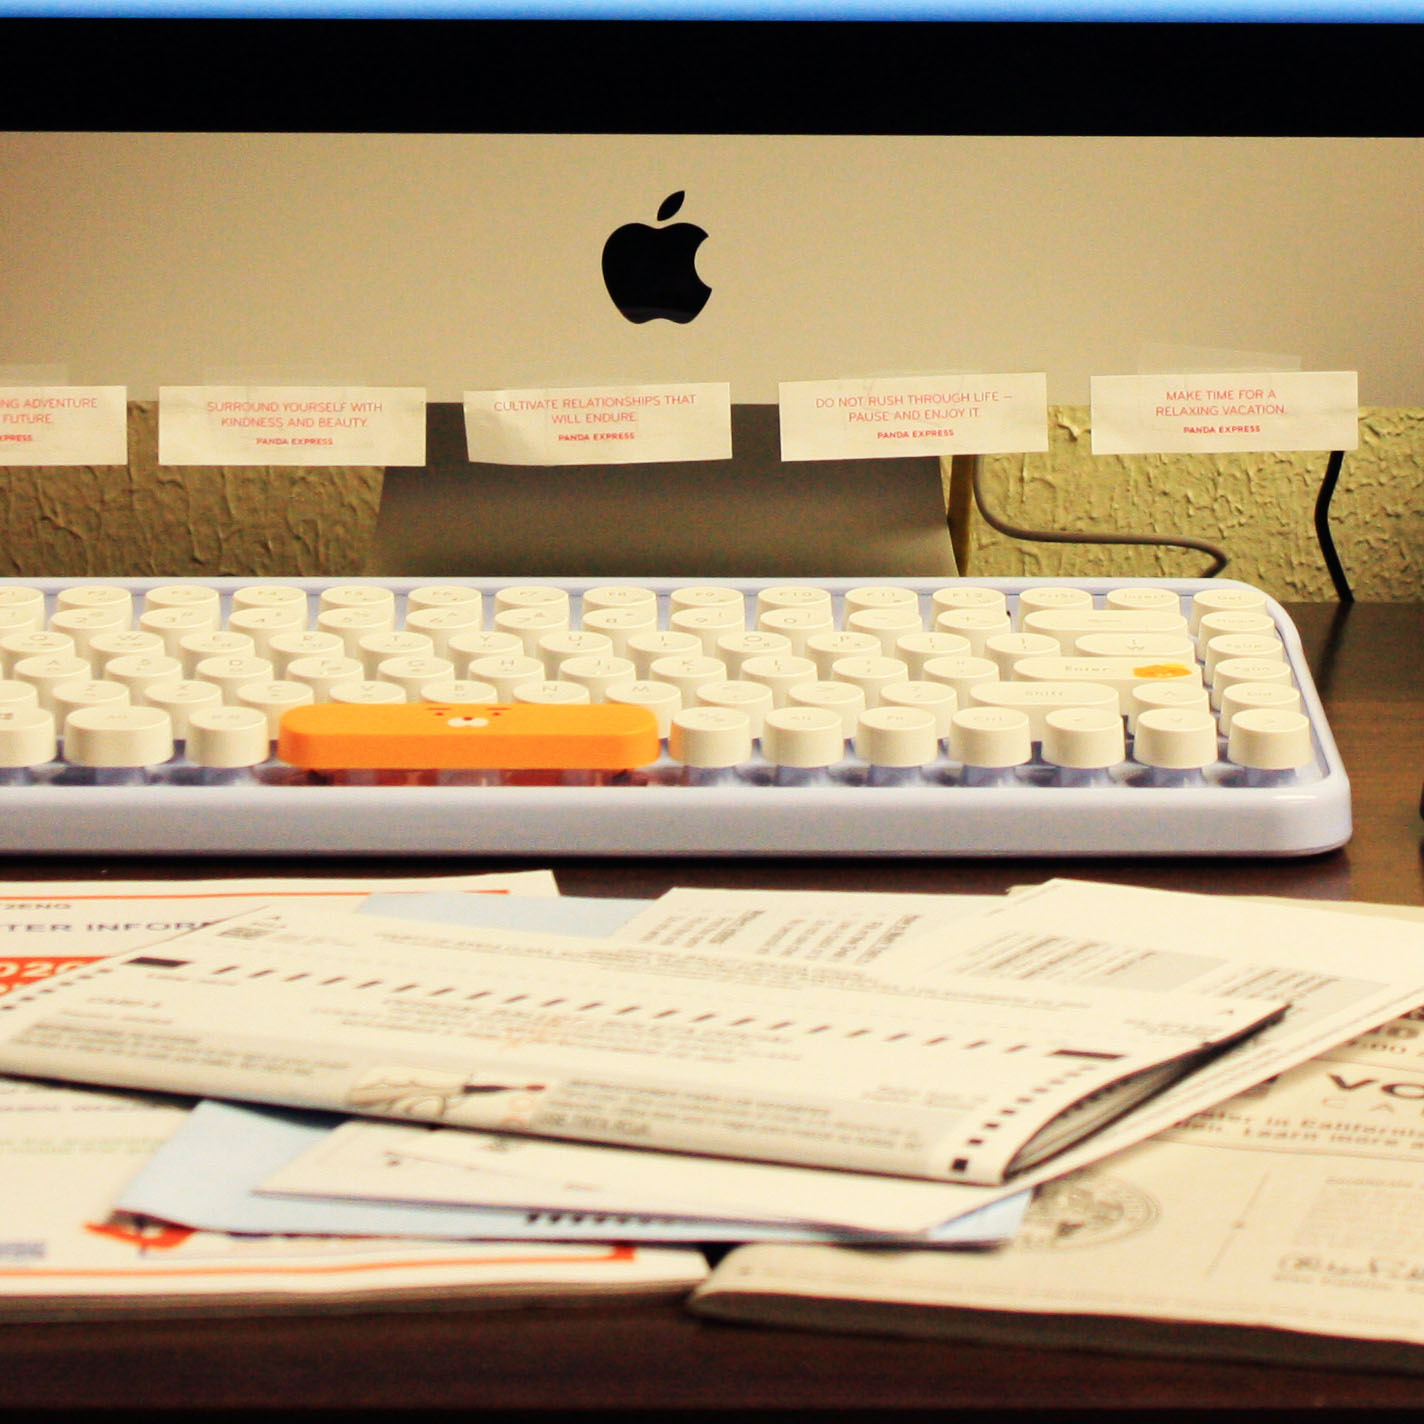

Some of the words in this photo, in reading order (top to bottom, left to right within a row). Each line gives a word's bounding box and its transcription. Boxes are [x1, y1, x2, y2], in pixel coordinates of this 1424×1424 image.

[816, 398, 834, 408] DO
[838, 397, 863, 408] NOT
[868, 395, 903, 406] RUSH
[907, 392, 970, 405] THROUGH
[974, 392, 999, 402] LIFE
[1166, 390, 1202, 401] MAKE
[1205, 390, 1234, 401] TIME
[1238, 389, 1264, 400] FOR
[1267, 389, 1277, 399] A
[23, 398, 98, 409] ADVENTURE
[207, 402, 280, 412] SURROUND
[283, 402, 348, 412] YOURSELF
[351, 402, 383, 412] WITH
[494, 398, 558, 411] CULTIVATE
[562, 396, 661, 409] RELATIONSHIPS
[663, 394, 696, 405] THAT
[848, 411, 889, 423] PAUSE
[893, 409, 920, 420] AND
[924, 408, 966, 420] ENJOY
[1155, 405, 1219, 416] RELAXING
[221, 417, 283, 427] KINDNESS
[288, 418, 314, 427] AND
[551, 414, 581, 424] WILL
[877, 431, 909, 439] PANDA
[912, 429, 954, 438] EXPRESS
[1183, 426, 1216, 434] PANDA
[1218, 425, 1261, 433] EXPRESS
[558, 433, 590, 441] PANDA
[593, 432, 635, 441] EXPRESS
